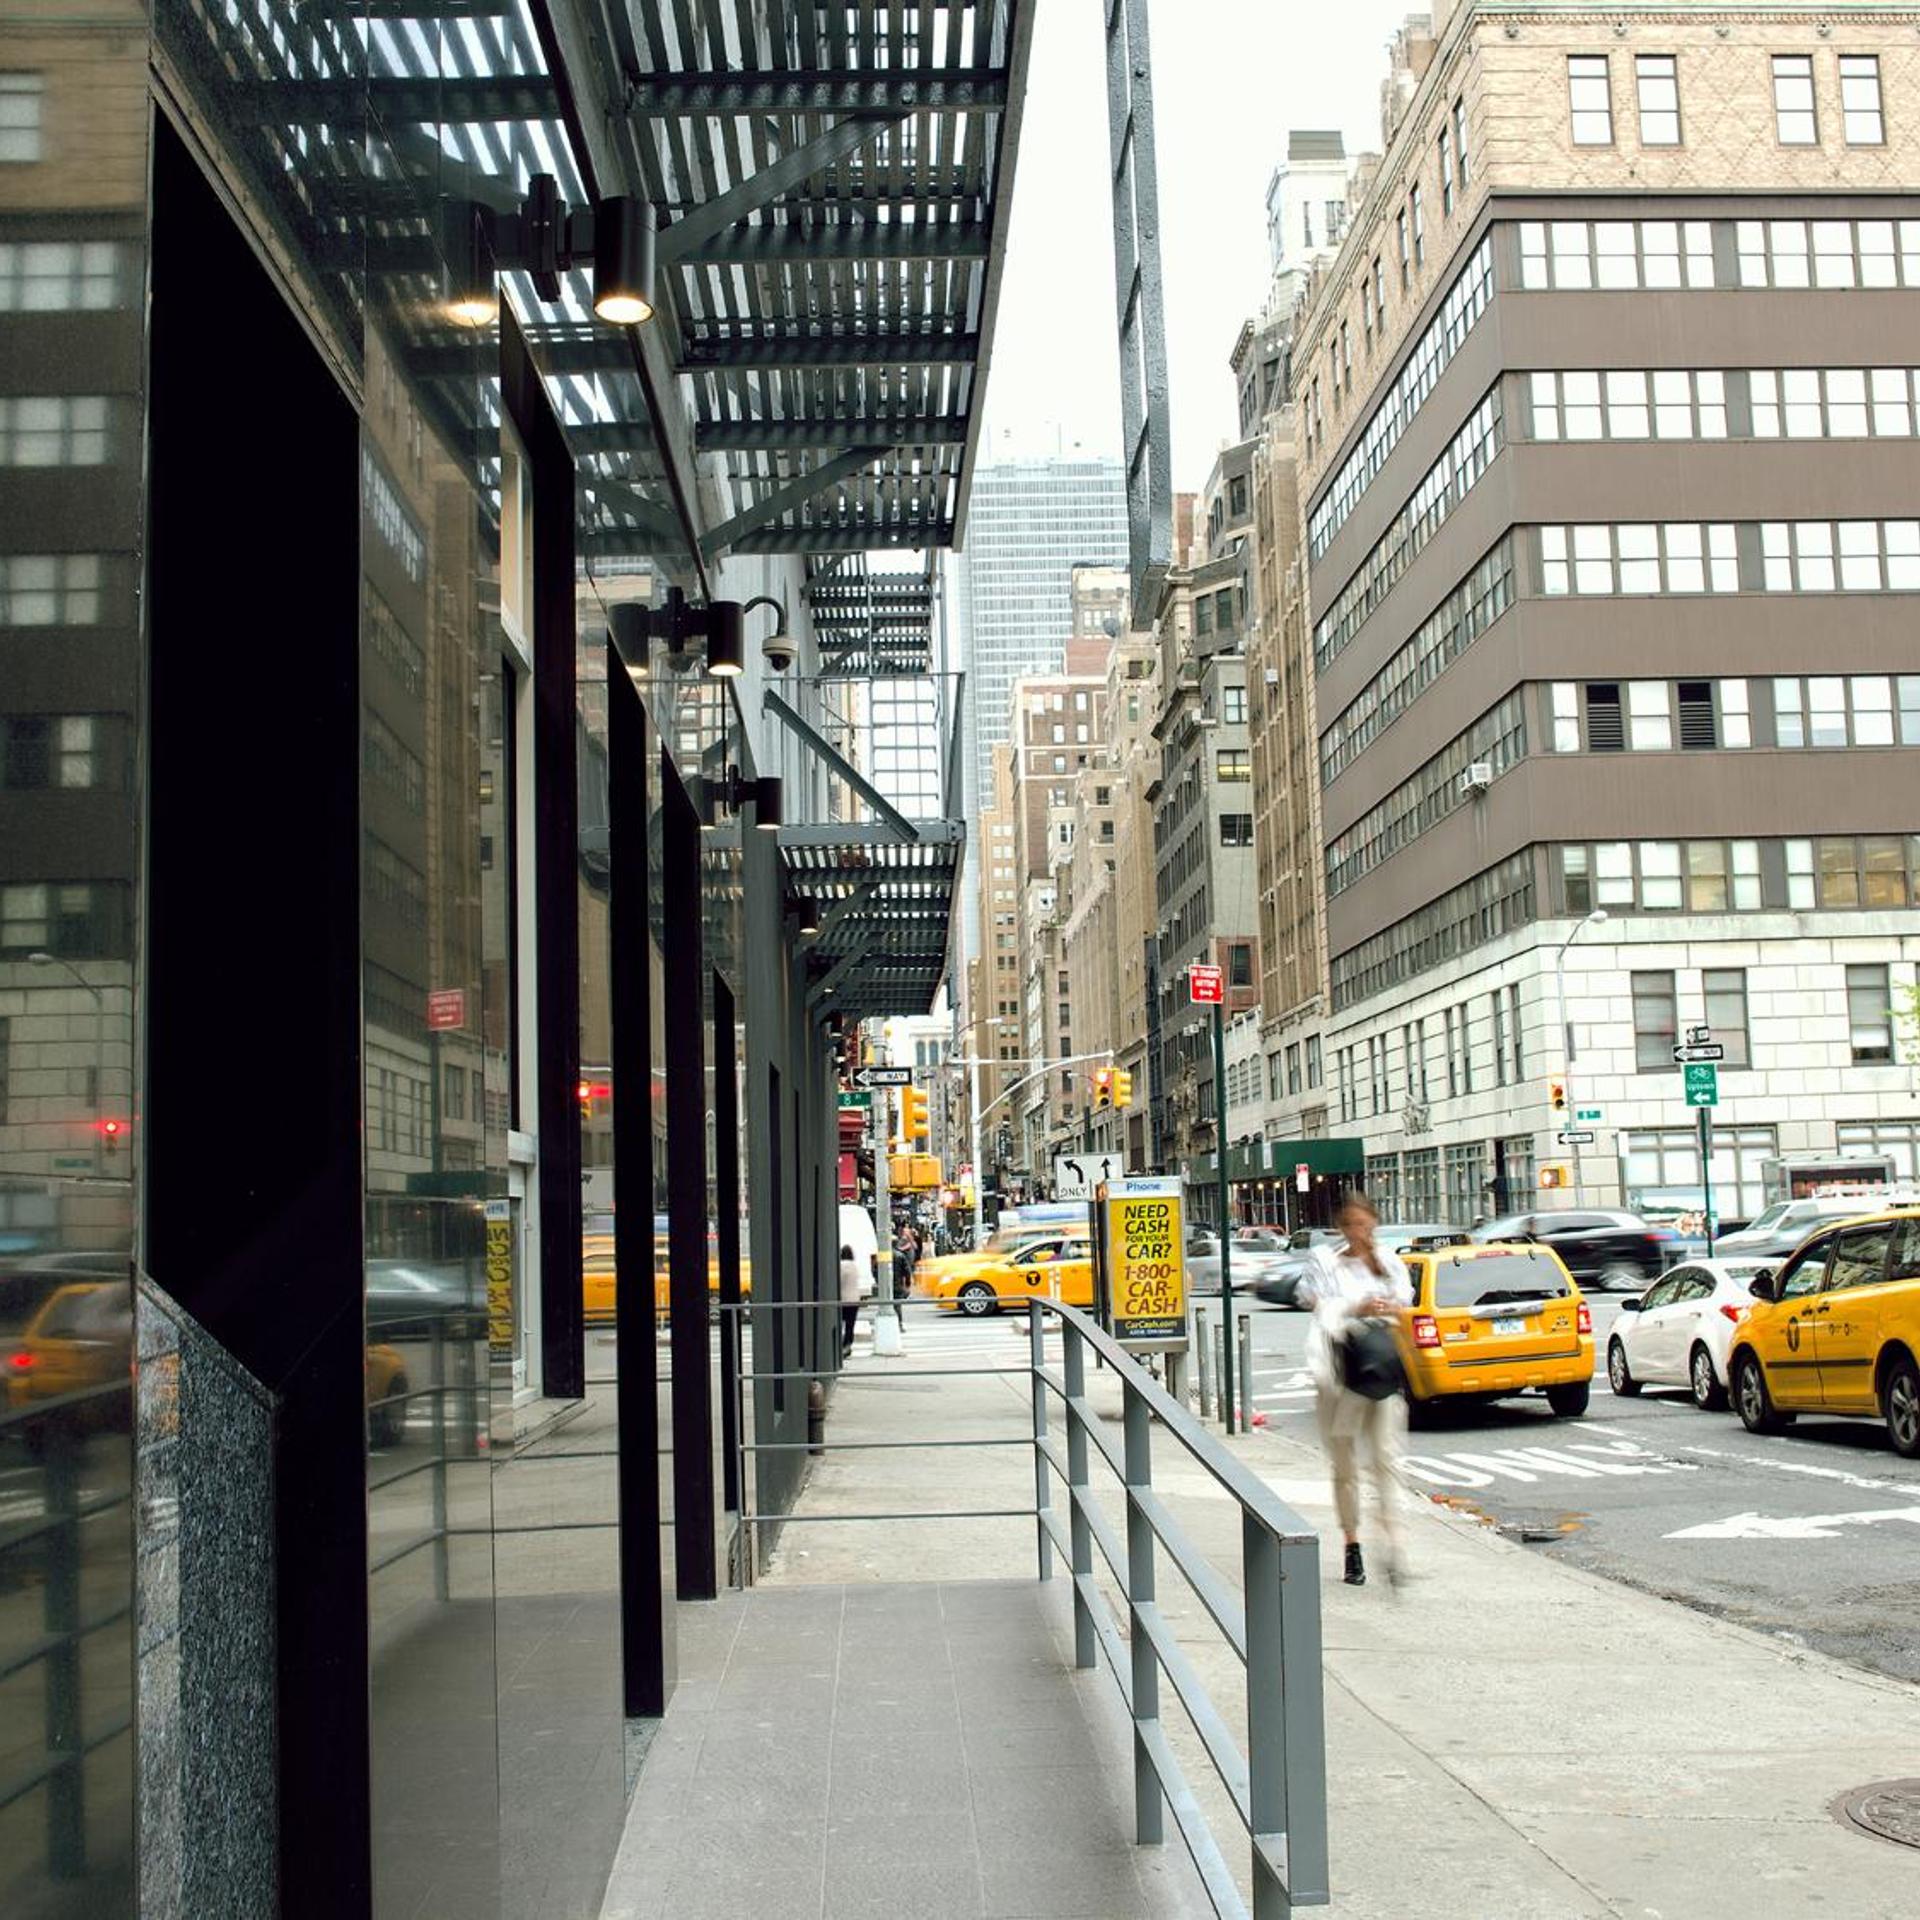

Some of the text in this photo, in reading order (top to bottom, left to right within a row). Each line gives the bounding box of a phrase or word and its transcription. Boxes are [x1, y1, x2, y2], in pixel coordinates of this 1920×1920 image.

[886, 1072, 905, 1080] WAY
[843, 1093, 851, 1106] 8
[1060, 1187, 1087, 1198] ONLY
[1126, 1182, 1161, 1192] Phone
[1124, 1204, 1169, 1219] NEED
[1125, 1219, 1170, 1234] CASH
[1125, 1234, 1169, 1243] FOR YOUR
[1126, 1243, 1172, 1260] CAR?
[1125, 1263, 1178, 1280] 1-800-
[1128, 1281, 1173, 1297] CAR-
[1125, 1297, 1178, 1315] CASH
[1393, 1441, 1673, 1487] ONLY
